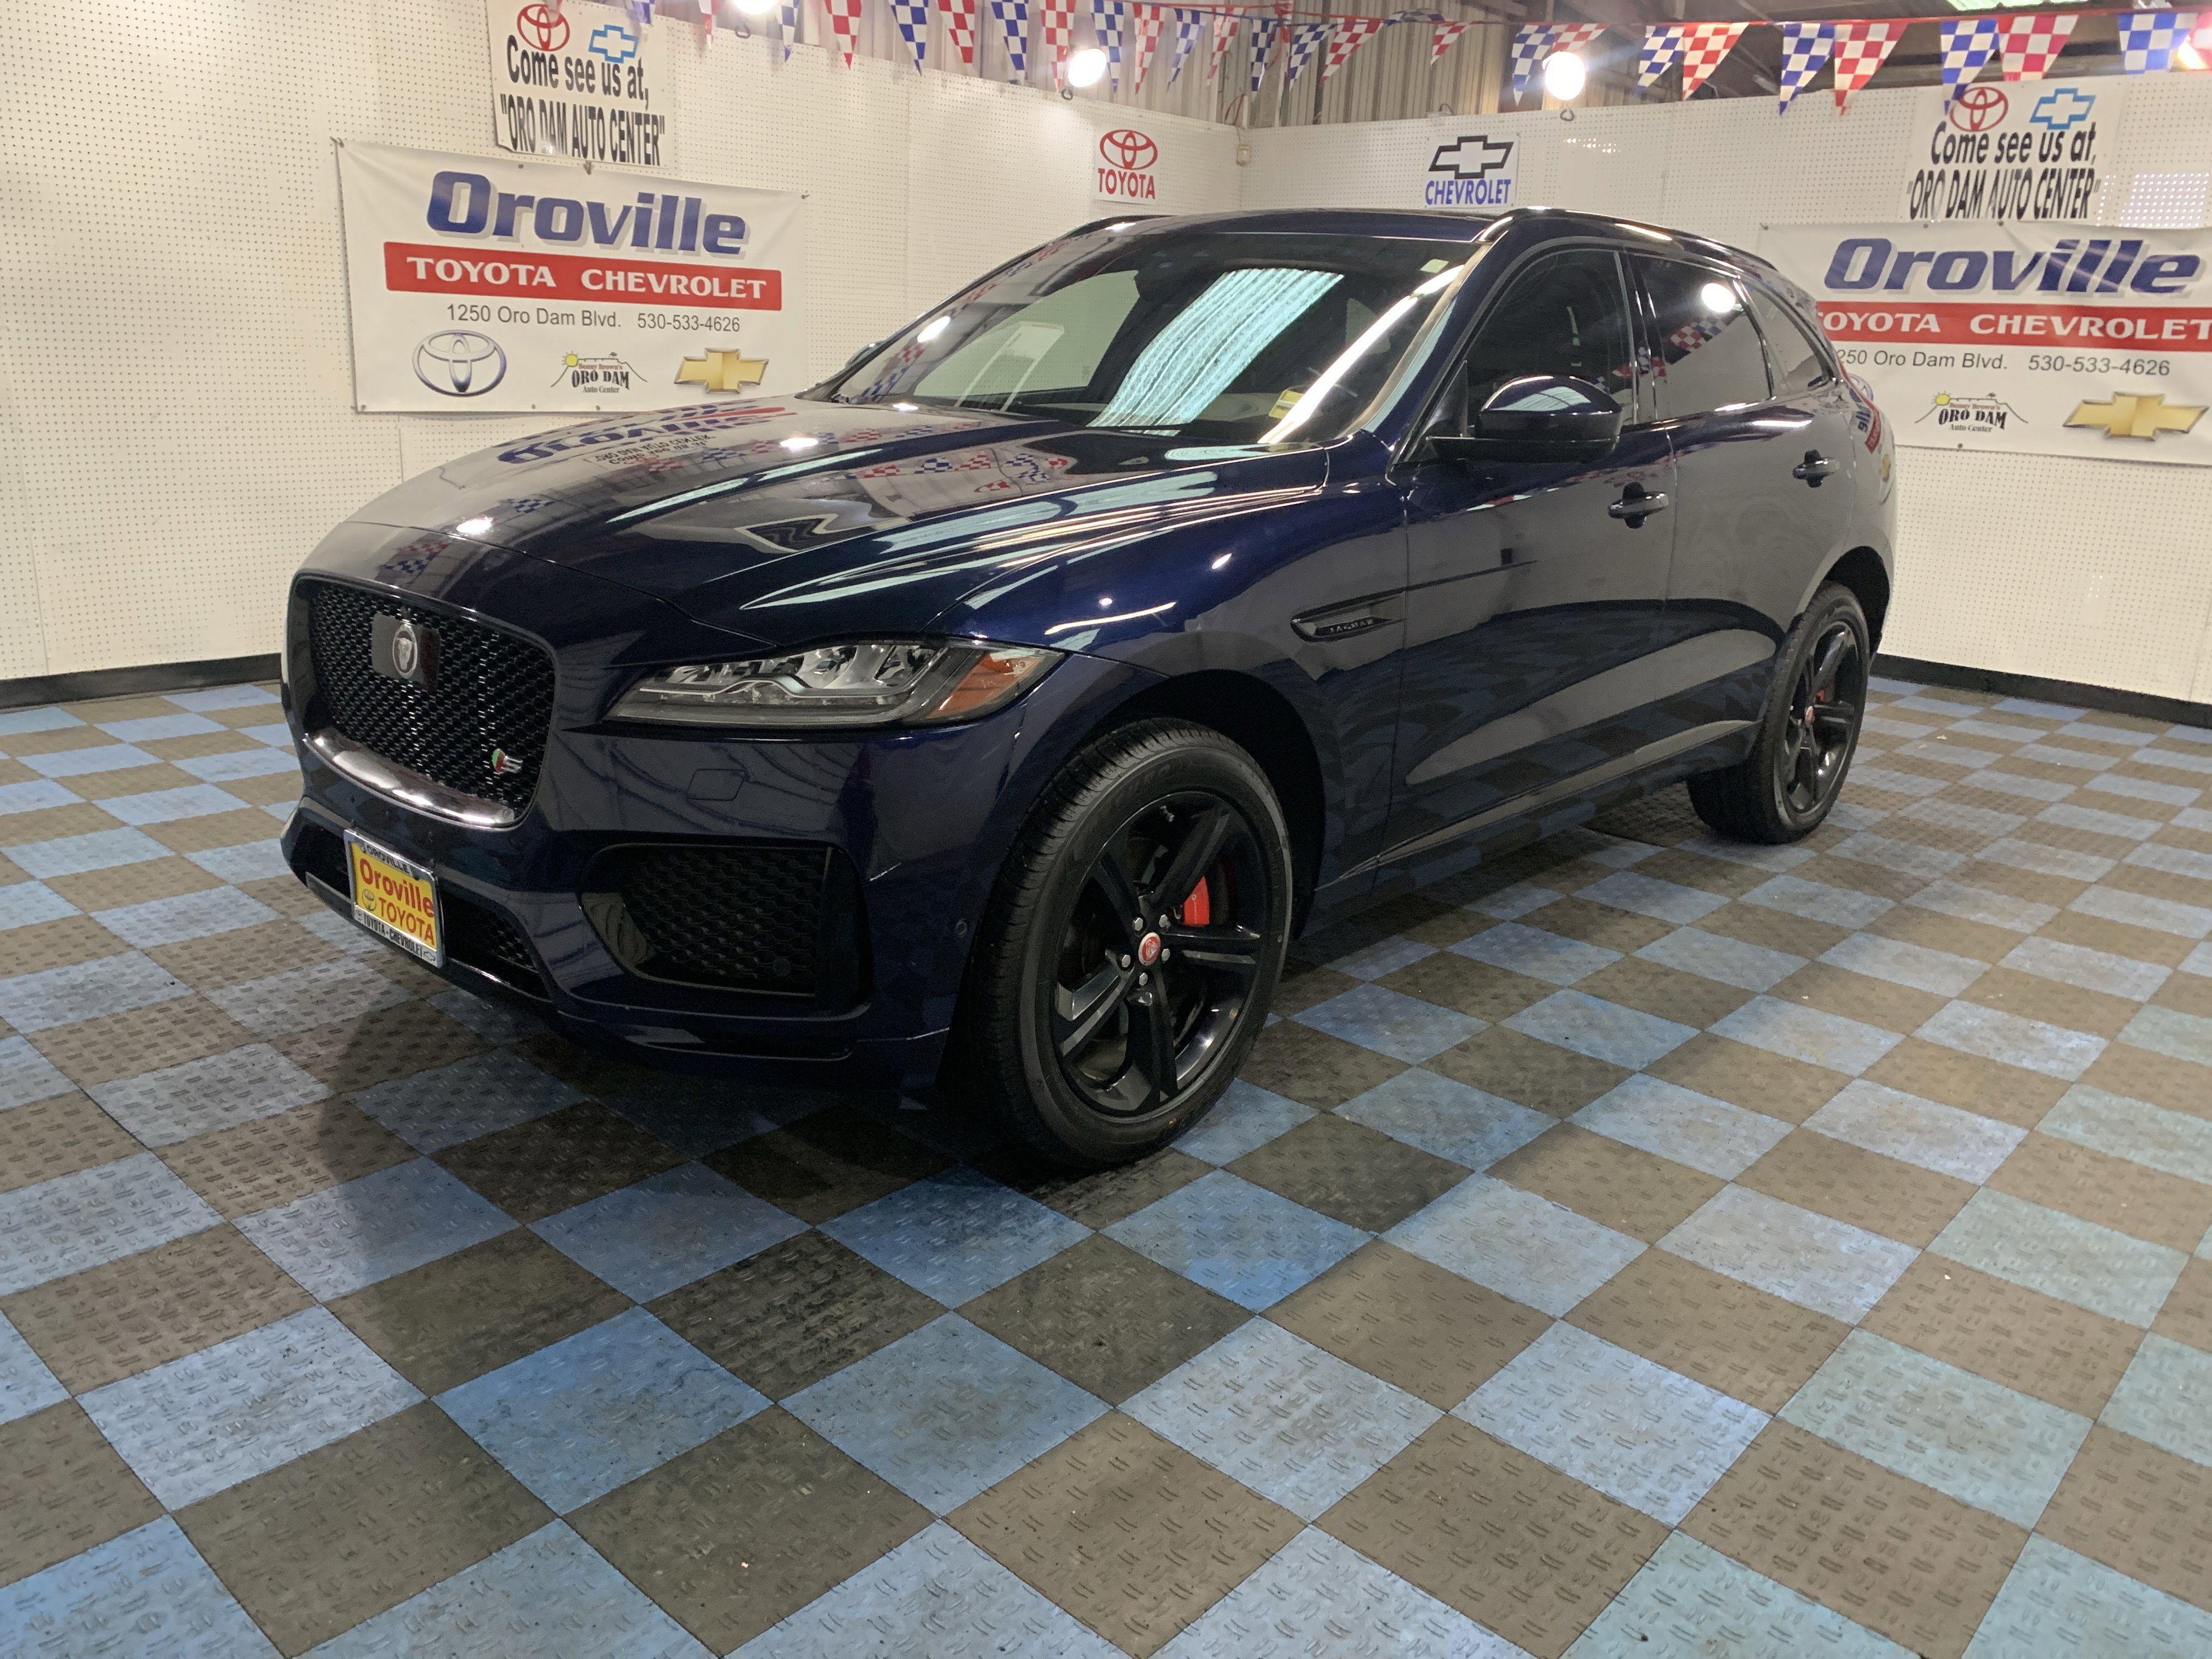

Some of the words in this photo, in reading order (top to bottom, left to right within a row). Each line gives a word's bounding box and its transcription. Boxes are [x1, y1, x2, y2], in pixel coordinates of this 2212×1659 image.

[506, 35, 558, 88] Come
[565, 57, 595, 93] see
[602, 61, 621, 98] us
[627, 57, 648, 110] at,
[500, 94, 535, 153] "ORO
[540, 99, 567, 155] DAM
[572, 104, 605, 161] AUTO
[610, 109, 665, 166] CENTER"
[1932, 121, 1989, 165] Come
[1995, 131, 2032, 162] see
[2039, 129, 2064, 161] us
[2070, 122, 2096, 165] at,
[1097, 167, 1156, 200] TOYOTA
[1426, 178, 1511, 205] CHEVROLET
[1907, 169, 1944, 219] "ORO
[1946, 170, 1985, 219] DAM
[1988, 168, 2033, 219] AUTO
[2034, 167, 2101, 219] CENTER"
[427, 171, 746, 255] Oroville
[407, 257, 556, 287] TOYOTA
[581, 269, 766, 299] CHEVROLET
[1824, 238, 2200, 293] Oroville
[447, 304, 491, 323] 1250
[498, 307, 531, 325] Oro
[537, 308, 575, 326] Dam
[582, 310, 621, 328] Blvd.
[637, 313, 740, 332] 530-533-4626
[1970, 313, 2212, 340] CHEVROLET
[572, 370, 598, 387] ORO
[603, 371, 629, 390] DAM
[1874, 350, 1906, 367] Oro
[1913, 352, 1956, 369] Dam
[1962, 353, 2007, 370] Blvd.
[2028, 354, 2170, 376] 530-533-4626
[1938, 409, 1970, 425] ORO
[1974, 410, 2007, 430] DAM
[1968, 424, 1993, 432] Center
[366, 845, 409, 873] OROVILLE
[360, 858, 435, 918] Oroville
[364, 914, 385, 935] TOYOTA
[390, 928, 423, 957] CHEVROLET
[379, 897, 435, 946] TOYOTA
